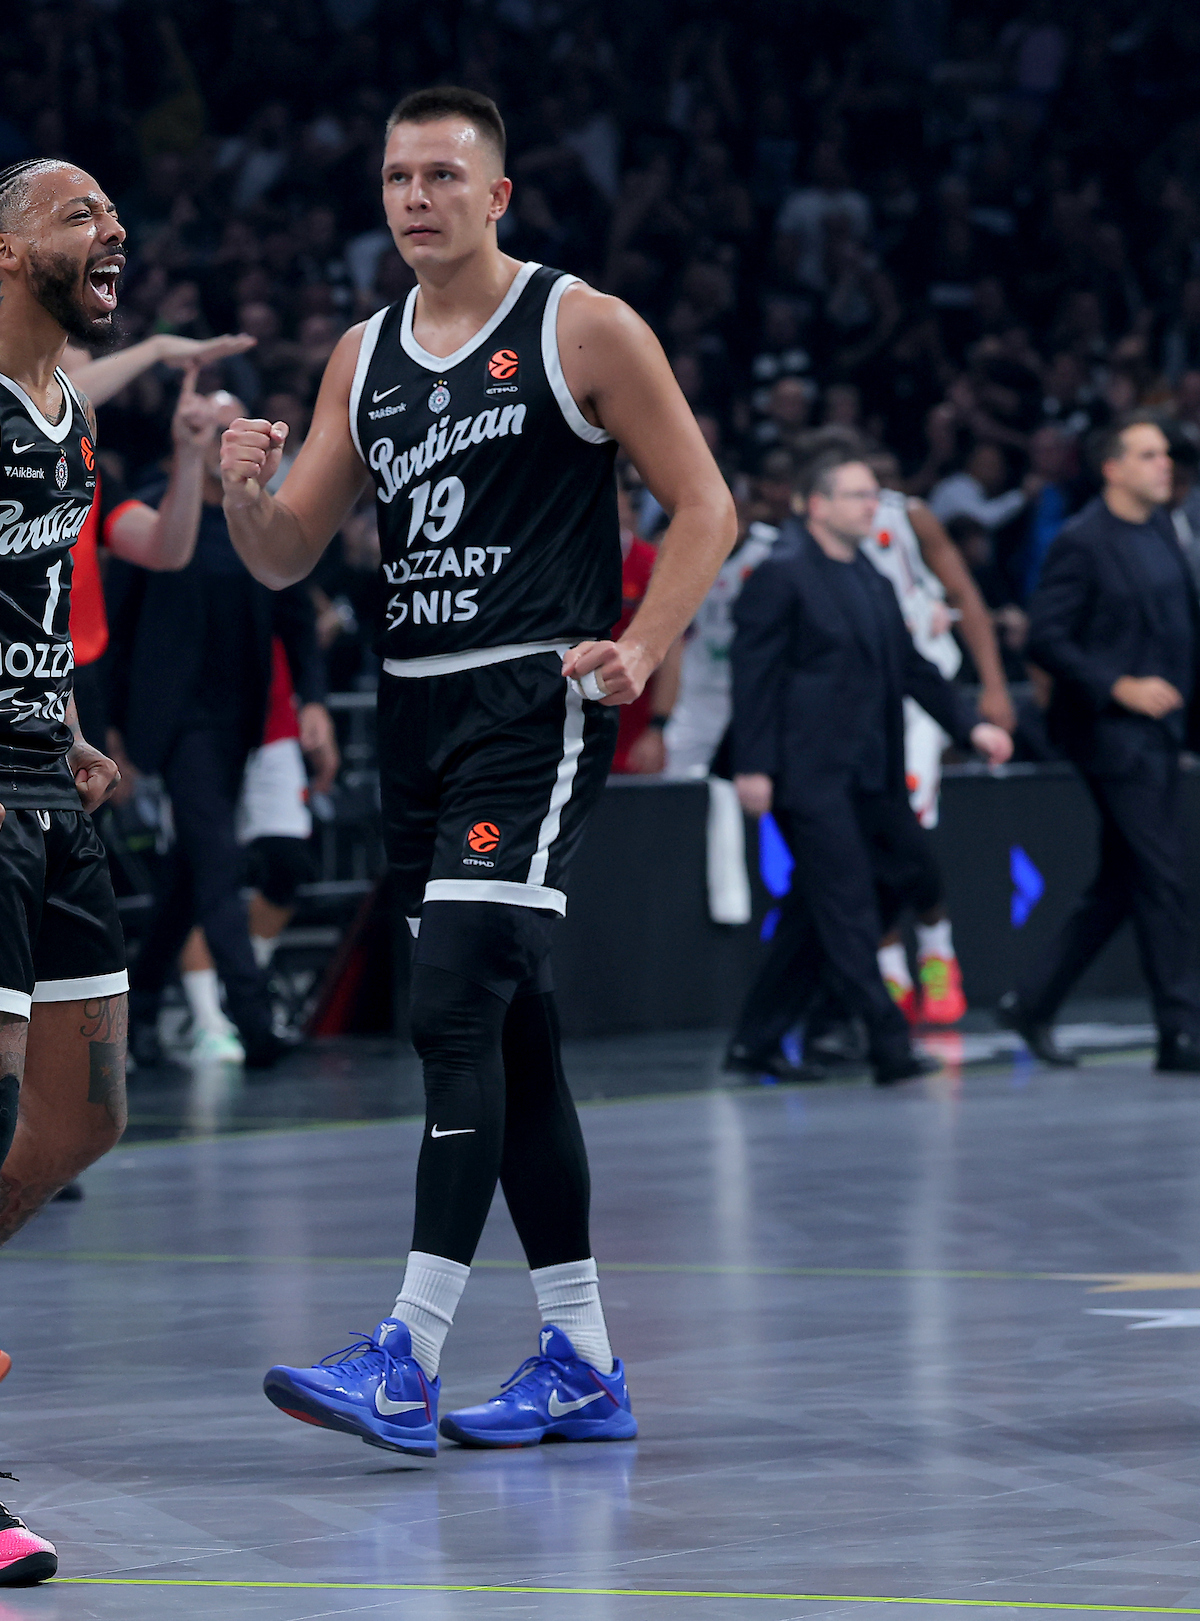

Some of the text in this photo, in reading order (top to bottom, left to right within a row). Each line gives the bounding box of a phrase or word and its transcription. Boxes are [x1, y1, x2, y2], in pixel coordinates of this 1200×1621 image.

[10, 466, 45, 479] AikBank
[369, 403, 527, 503] Partizan
[406, 476, 466, 548] 19
[382, 546, 512, 584] OZZART
[42, 559, 62, 636] 1
[412, 588, 480, 625] NIS
